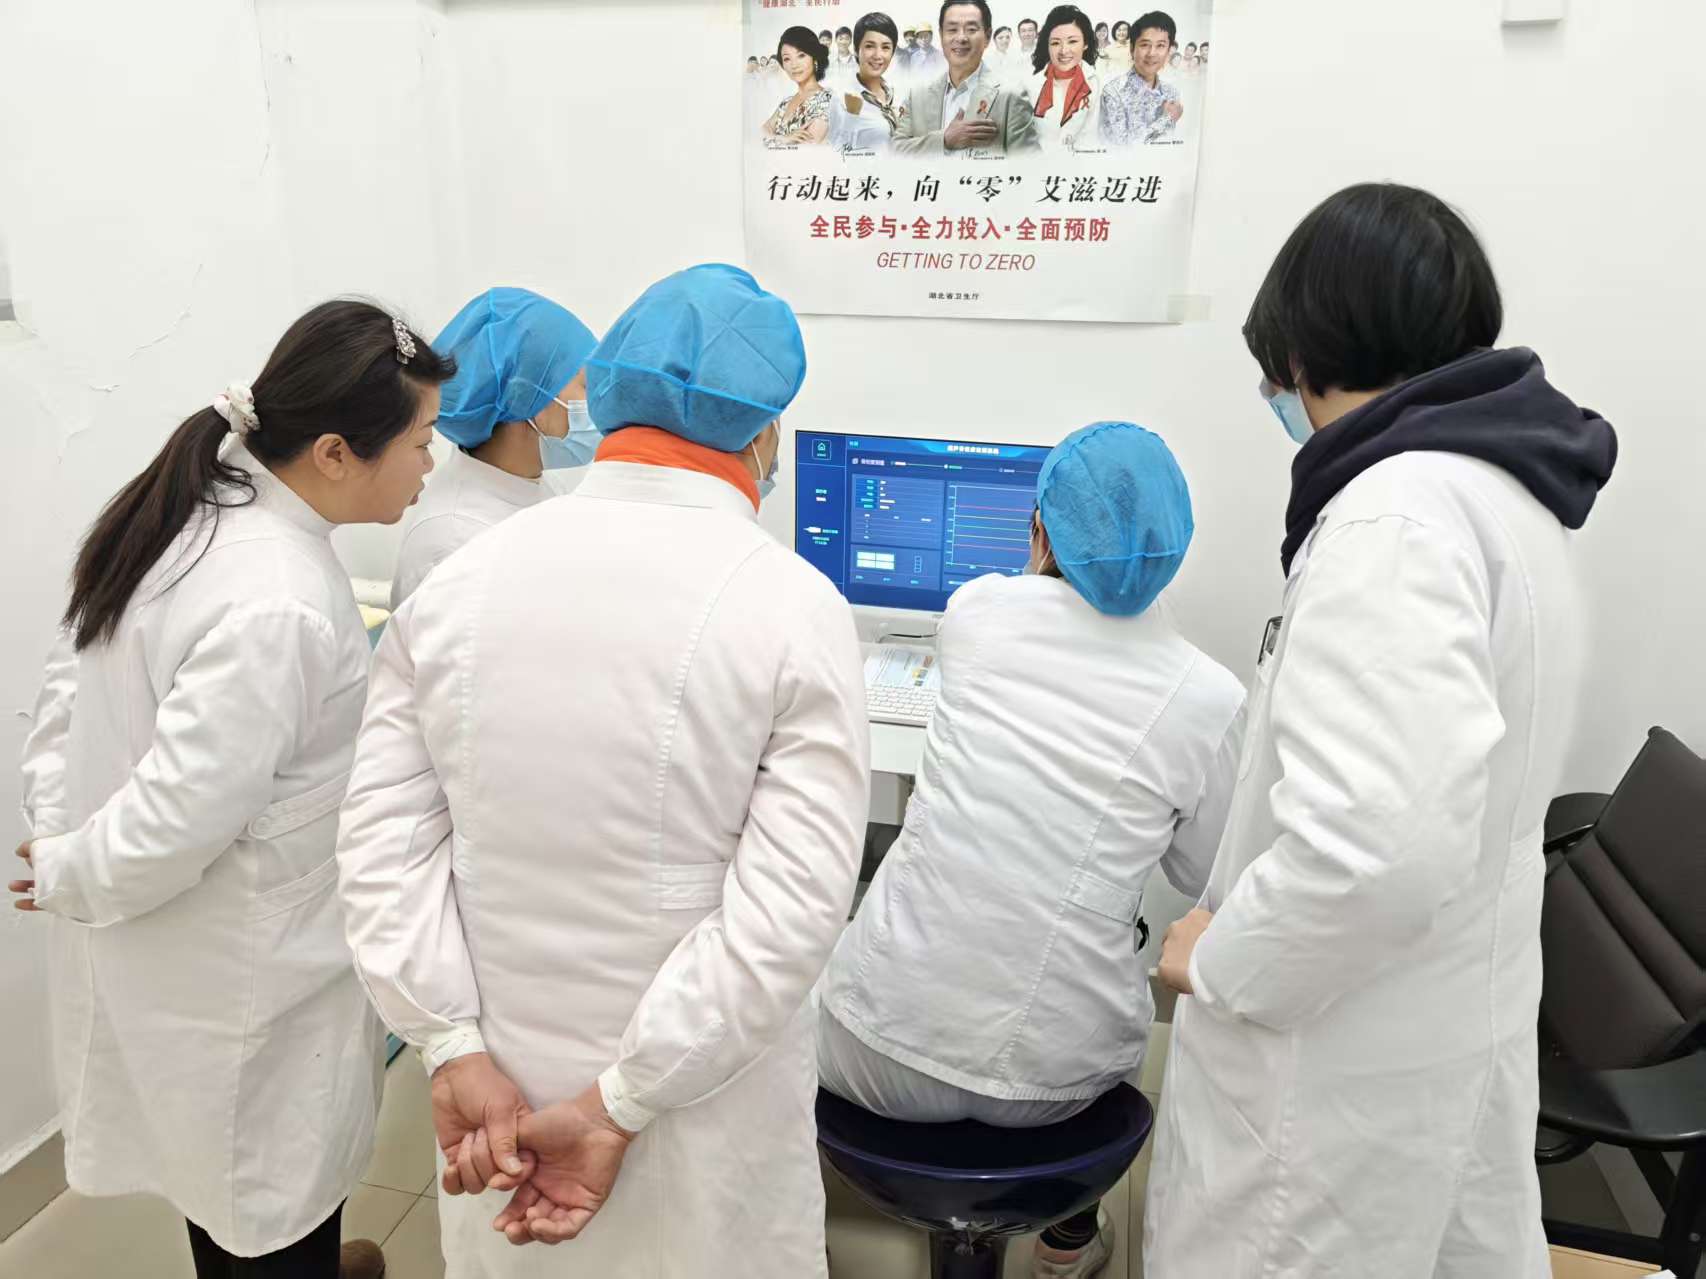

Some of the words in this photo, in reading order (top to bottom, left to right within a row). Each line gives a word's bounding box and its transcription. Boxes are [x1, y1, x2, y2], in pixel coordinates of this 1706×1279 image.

[876, 252, 953, 270] GETTING
[959, 252, 983, 270] TO
[985, 253, 1036, 271] ZERO
[928, 292, 980, 301] 湖北省卫生厅
